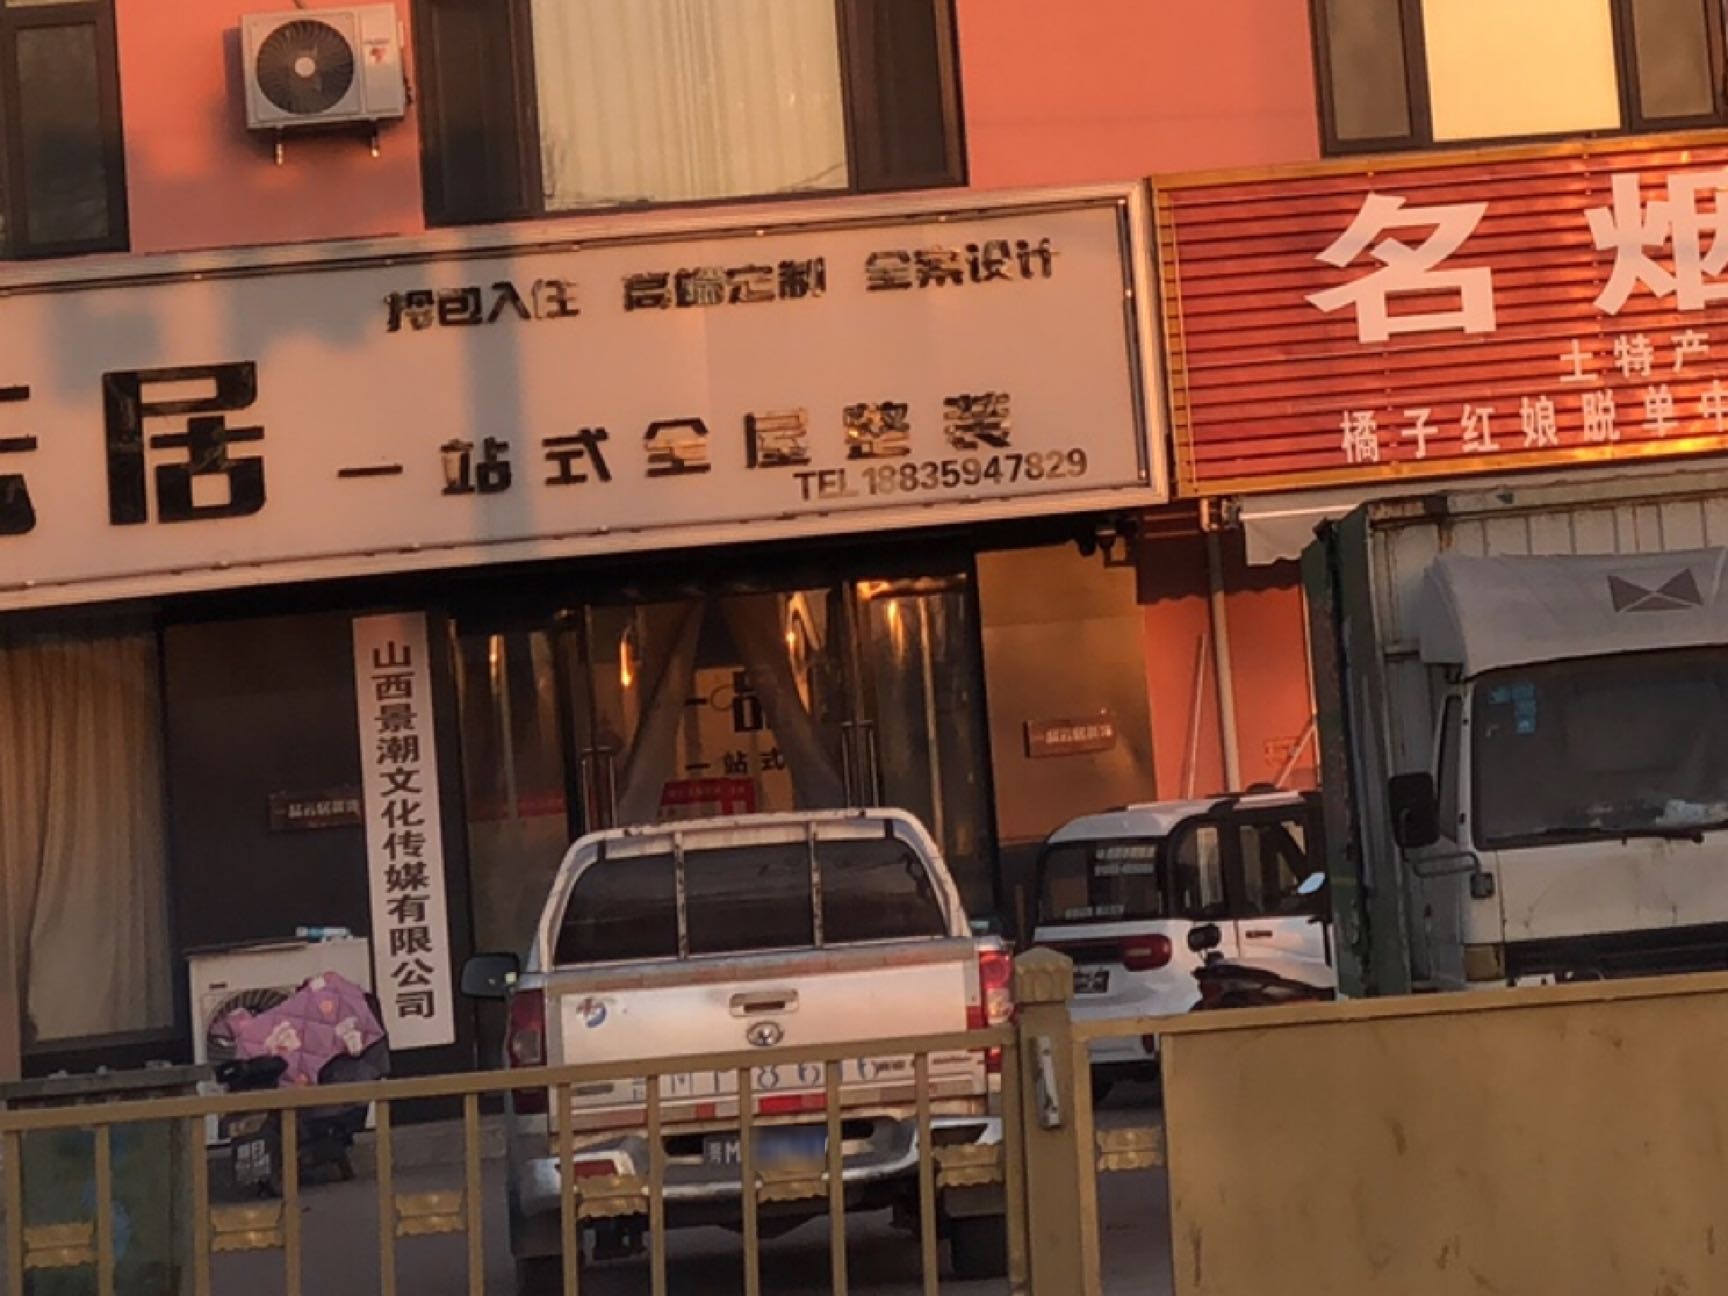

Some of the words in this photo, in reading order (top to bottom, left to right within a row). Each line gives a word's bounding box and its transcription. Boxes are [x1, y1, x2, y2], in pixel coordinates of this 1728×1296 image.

[383, 278, 582, 333] 拎包入住
[622, 256, 828, 313] 高端定制
[864, 238, 1056, 294] 全案设计
[1559, 330, 1710, 384] 土特产
[0, 360, 267, 536] 居
[793, 467, 854, 501] TEL
[866, 446, 1089, 497] 18835947829
[370, 640, 436, 1020] 山西景潮文化传媒有限公司
